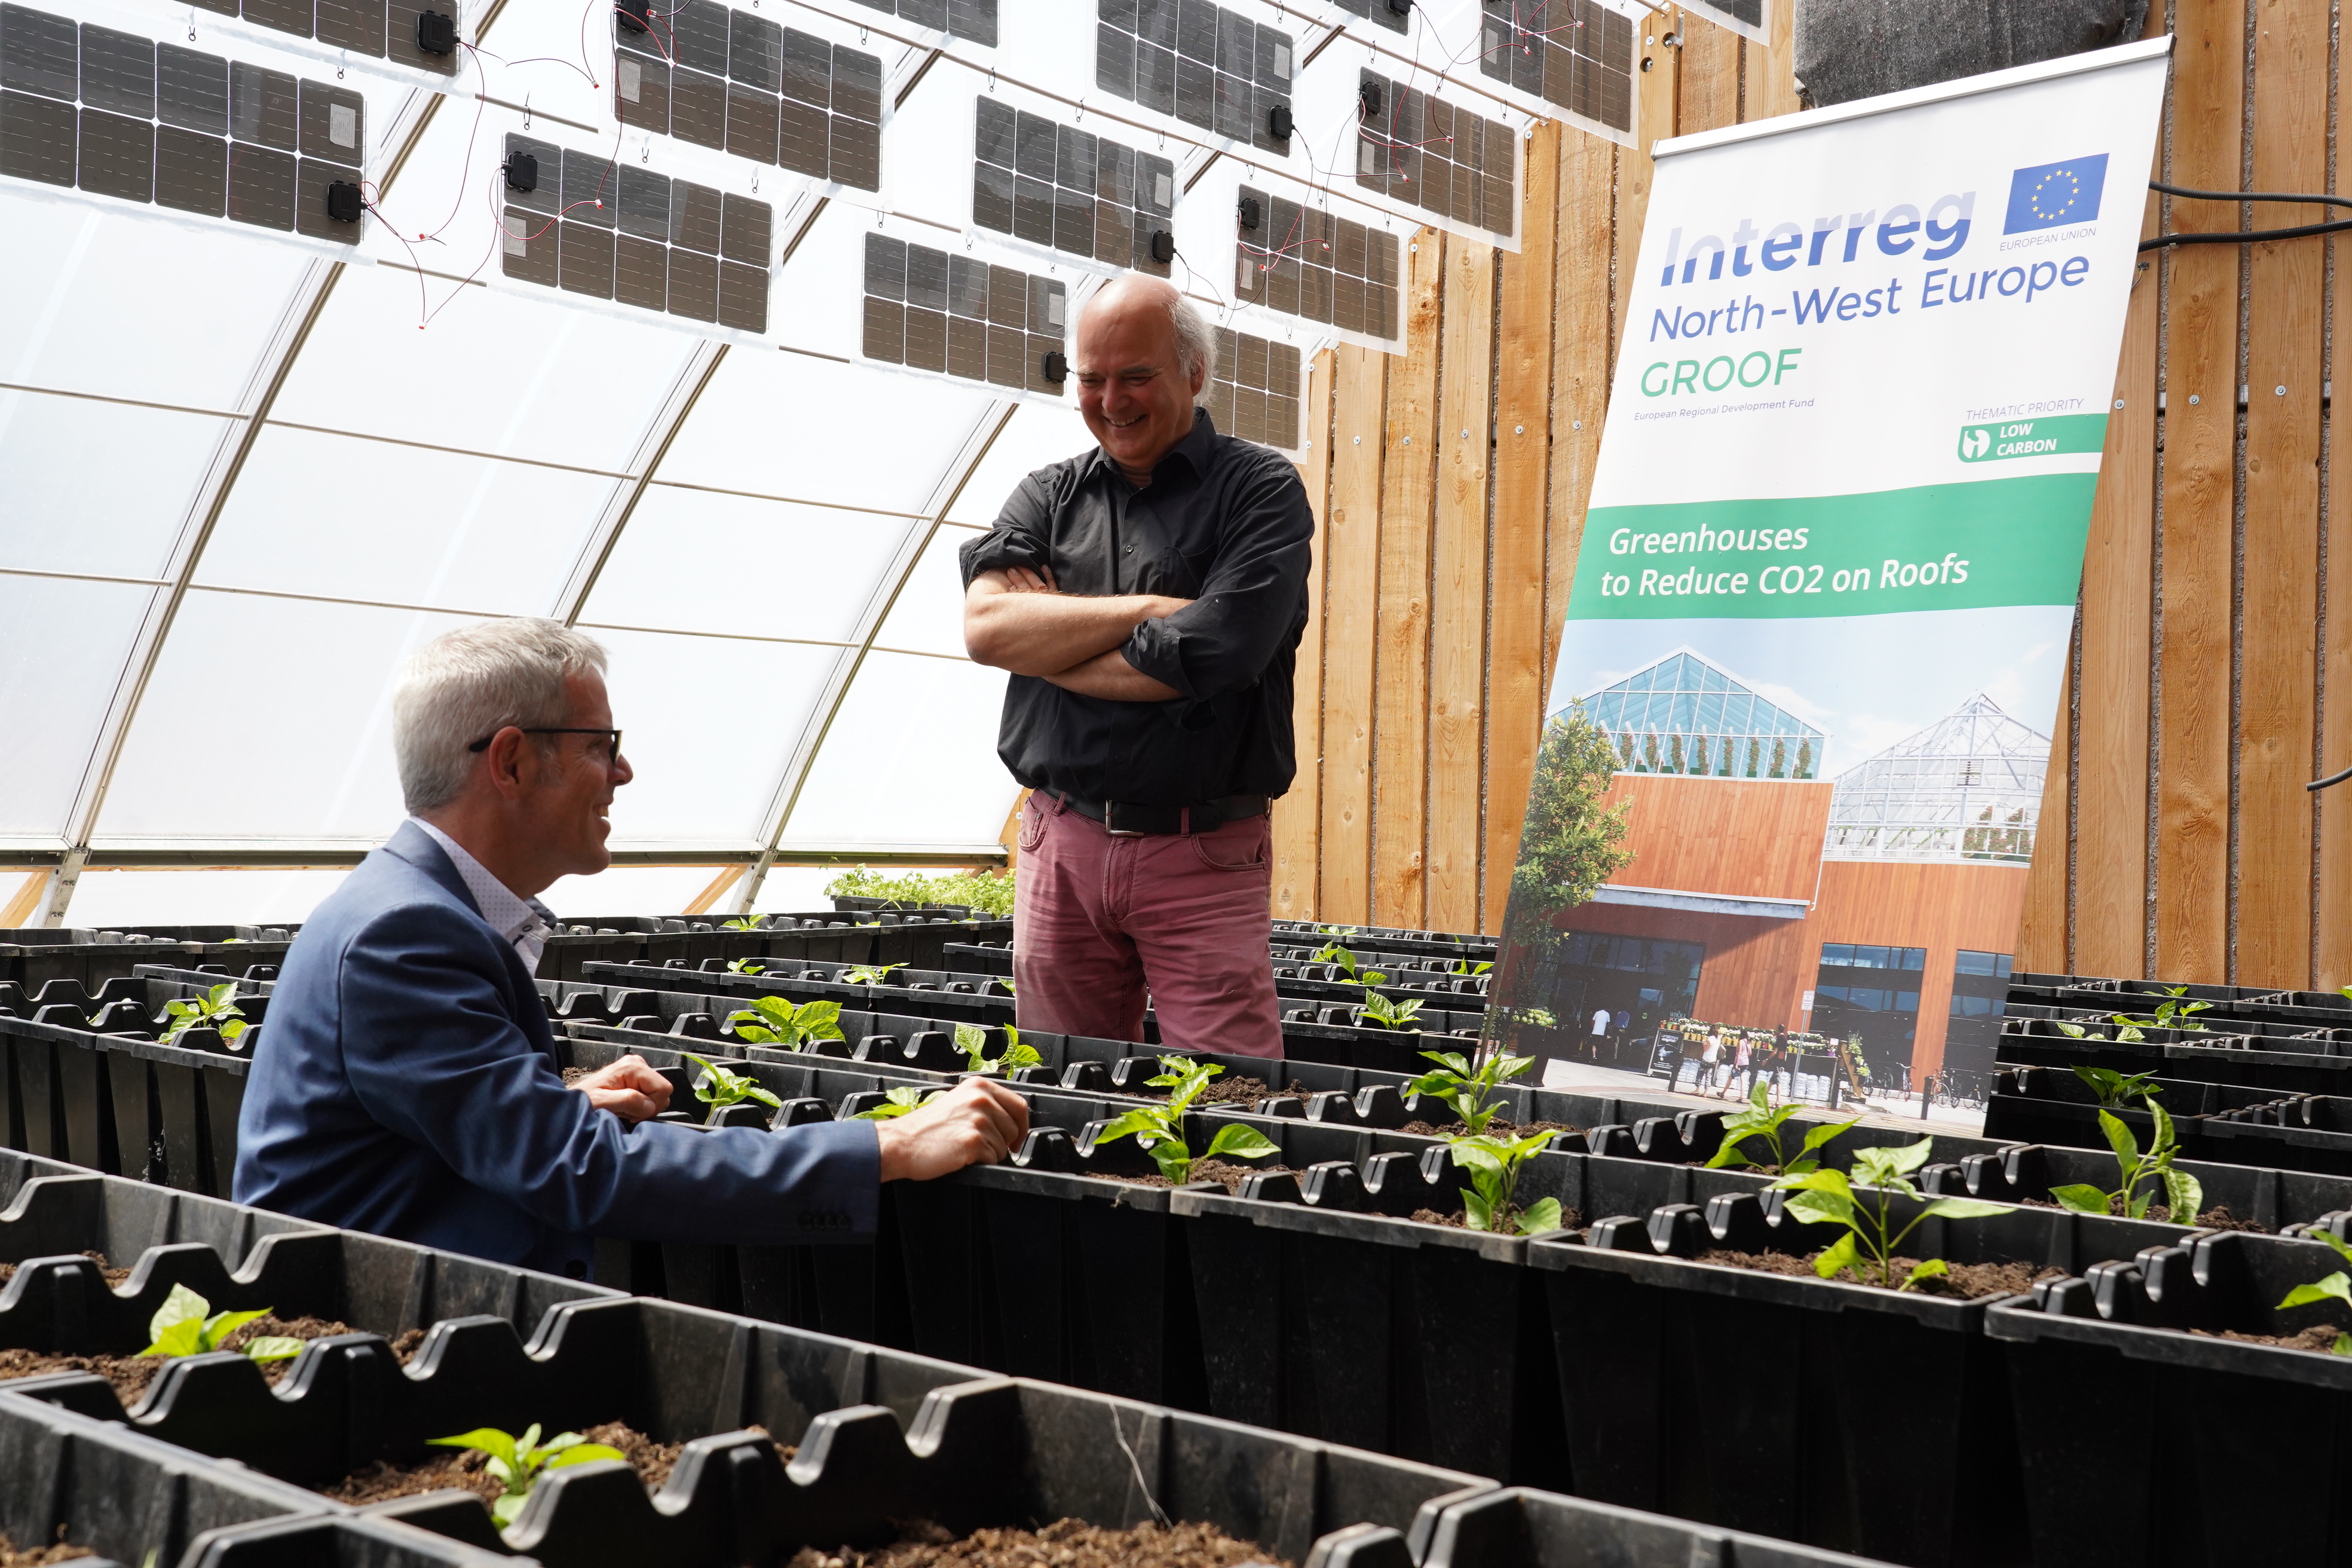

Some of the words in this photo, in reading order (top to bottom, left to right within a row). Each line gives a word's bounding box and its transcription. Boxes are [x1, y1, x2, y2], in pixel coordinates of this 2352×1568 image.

[1661, 191, 1976, 287] Interreg
[1999, 234, 2058, 251] EUROPEAN
[2062, 228, 2096, 240] UNION
[1649, 277, 1902, 342] North-West
[1921, 256, 2089, 308] Europe
[1641, 348, 1802, 397] GROOF
[1634, 410, 1677, 421] European
[1680, 405, 1719, 418] Regional
[1722, 400, 1786, 414] Development
[1788, 398, 1814, 408] Fund
[1966, 404, 2025, 420] THEMATIC
[2028, 398, 2084, 413] PRIORITY
[2000, 422, 2034, 438] LOW
[1996, 439, 2057, 456] CARBON
[1610, 523, 1809, 555] Greenhouses
[1601, 571, 1630, 596] to
[1639, 565, 1748, 596] Reduce
[1759, 565, 1823, 595] CO2
[1833, 568, 1871, 592] on
[1880, 552, 1970, 589] Roofs
